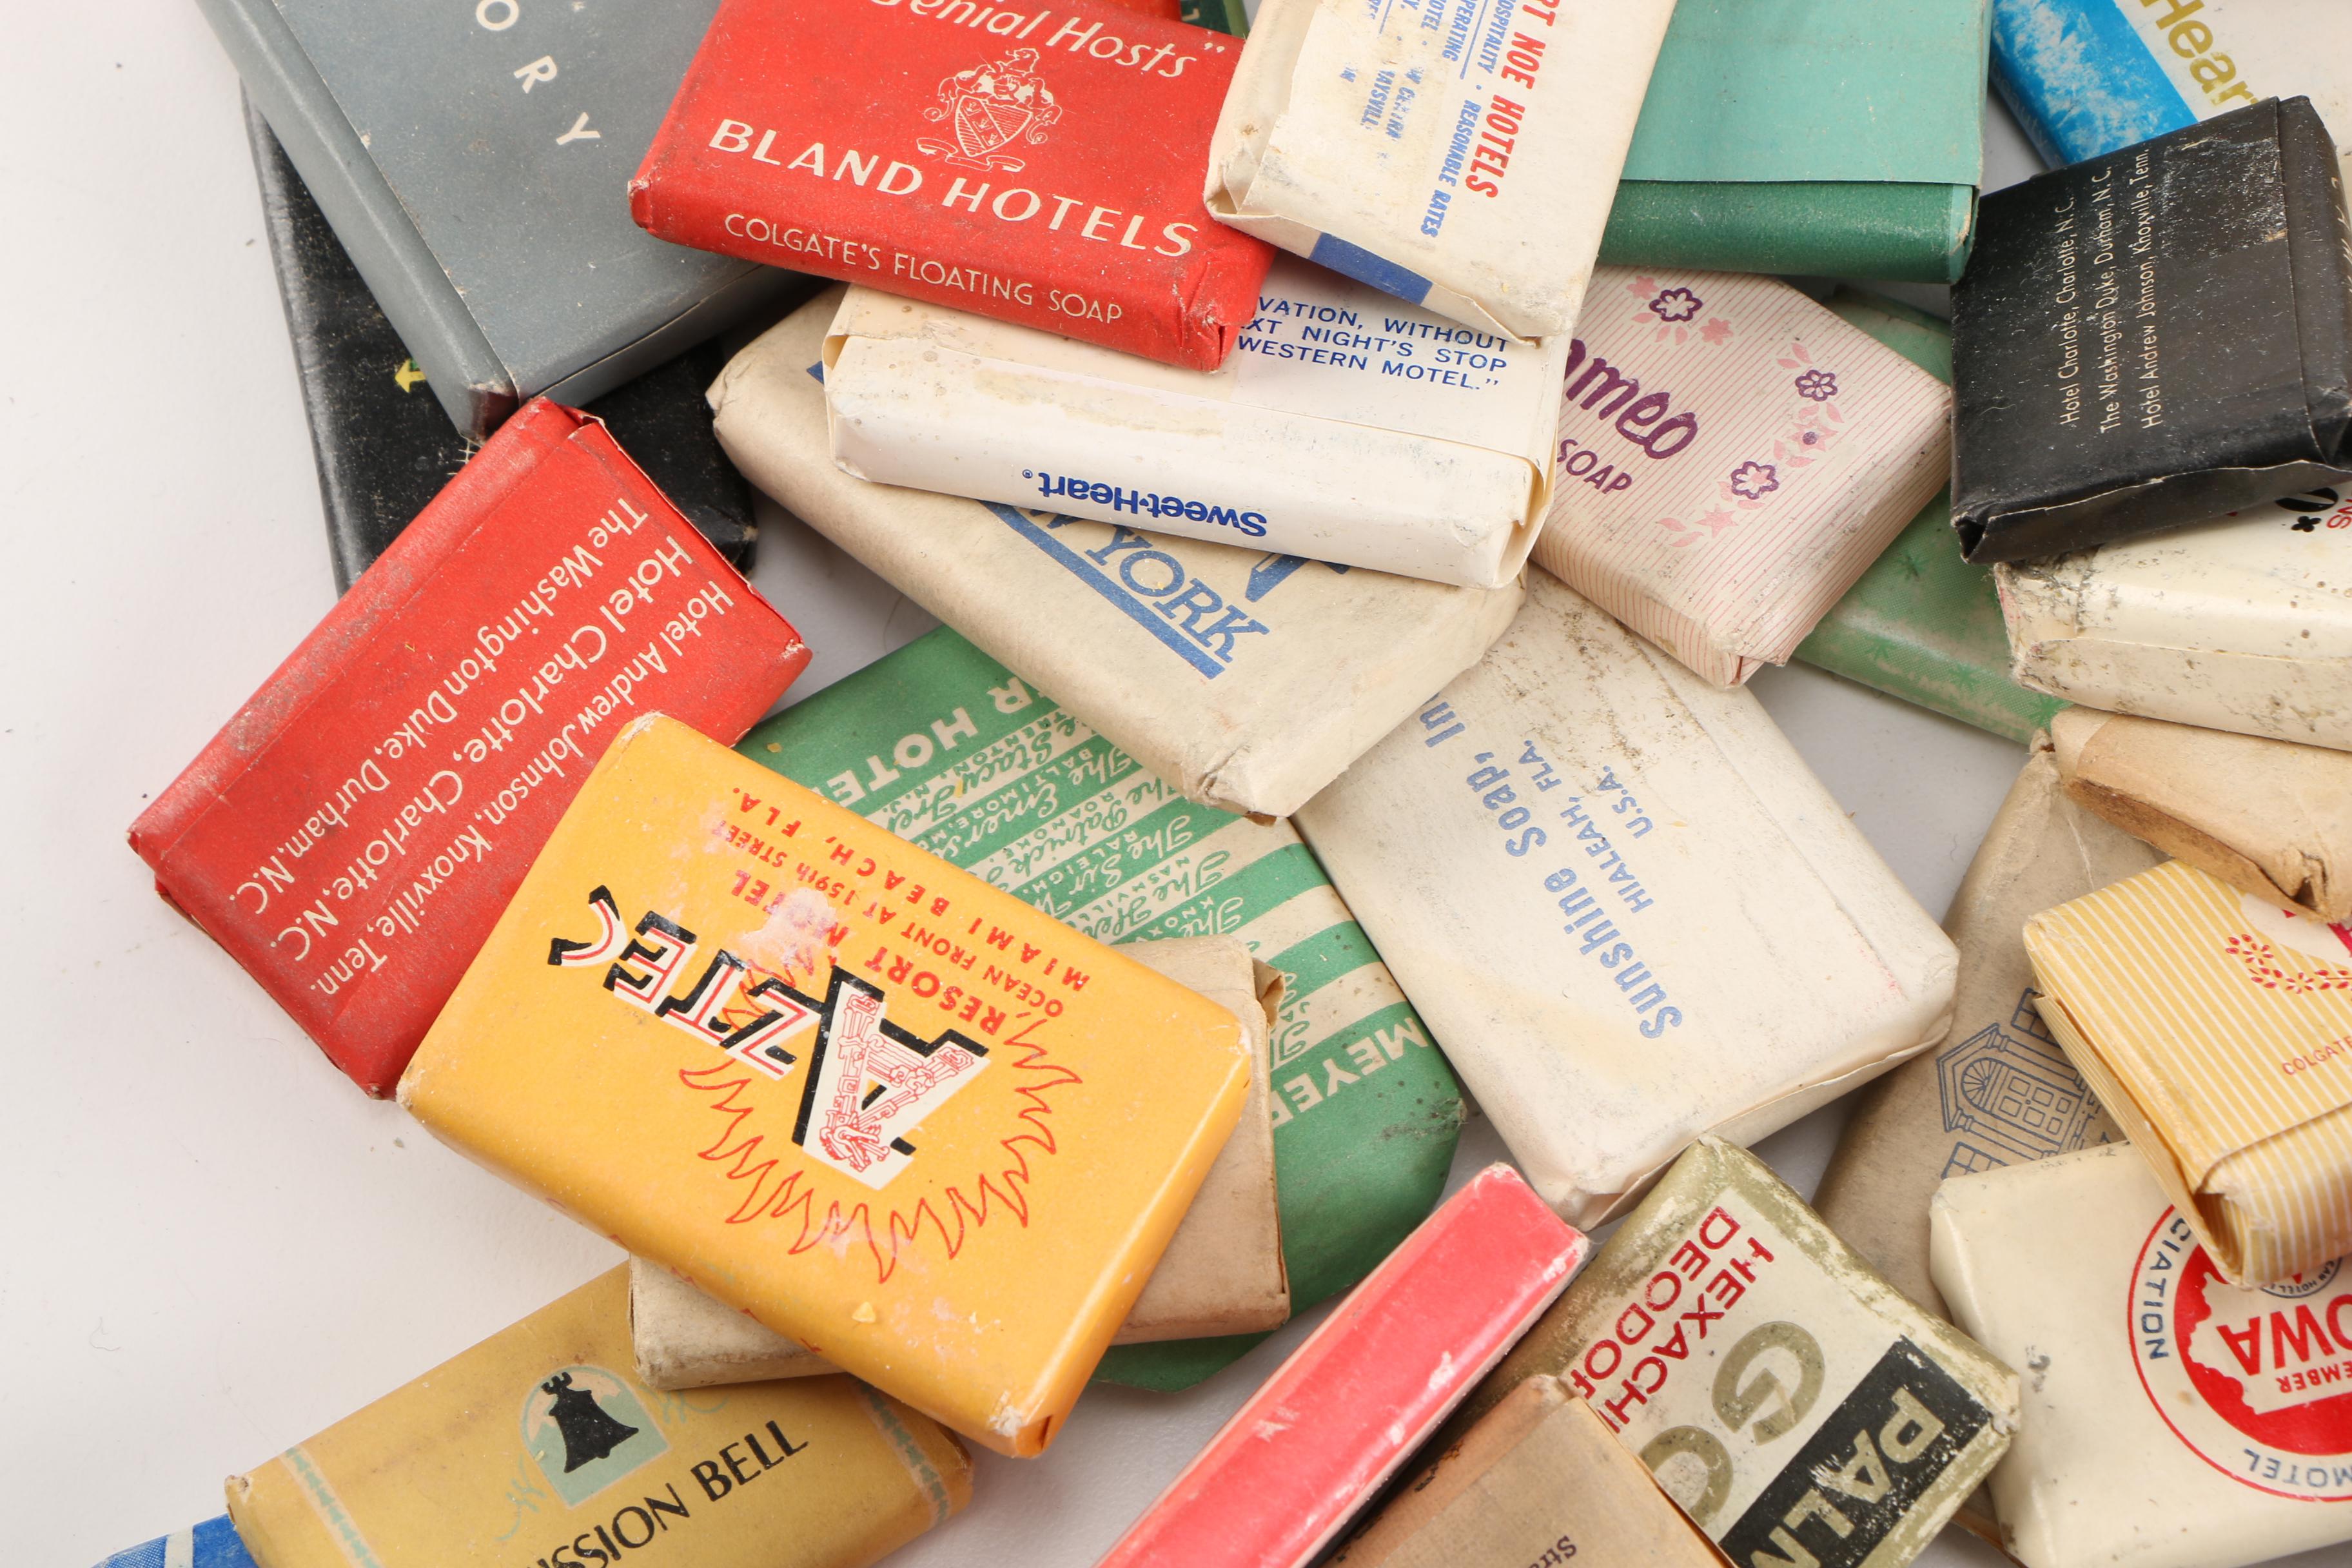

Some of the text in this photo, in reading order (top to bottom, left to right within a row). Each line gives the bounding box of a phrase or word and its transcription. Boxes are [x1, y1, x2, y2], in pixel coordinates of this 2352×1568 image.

[870, 0, 1049, 39] enial
[2141, 0, 2259, 106] Hear
[1501, 32, 1546, 90] NOE
[1438, 100, 1482, 187] REASONABLE
[1465, 94, 1525, 198] HOTELS
[709, 119, 1199, 258] BLAND HOTELS
[1420, 190, 1451, 238] RATES
[725, 213, 1122, 324] COLGATE'S FLOATING SOAP
[2056, 233, 2077, 304] Charlotte,
[2093, 203, 2115, 265] Durham,
[2095, 265, 2118, 316] Duke,
[2129, 148, 2162, 429] Hotel Andrew Johnson, Knoxville, Tenn.
[1238, 335, 1368, 371] WESTERN
[1240, 317, 1508, 372] XT NIGHT'S STOP
[1384, 318, 1510, 353] WITHOUT
[2058, 306, 2079, 379] Charlotte,
[2099, 310, 2122, 400] Washington
[2060, 382, 2080, 426] Hotel
[2100, 401, 2121, 434] The
[1556, 438, 1632, 495] SOAP
[587, 498, 649, 548] The
[444, 544, 603, 696] Washington
[599, 535, 693, 634] Hotel
[1084, 524, 1270, 664] YORK
[373, 690, 458, 760] Duke,
[453, 625, 607, 763] Charlotte,
[309, 580, 734, 995] Hotel Andrew Johnson, Knoxville, Tenn.
[814, 707, 979, 808] HOTE
[276, 758, 391, 858] Durham,
[322, 770, 464, 901] Charlotte,
[732, 787, 802, 838] FLA.
[1015, 776, 1177, 877] he Patrick
[1130, 814, 1193, 860] The
[1518, 739, 1655, 914] HIALEAH, FLA.
[796, 861, 856, 905] 159th
[825, 836, 950, 917] BEACH,
[1068, 852, 1123, 896] Sir
[1152, 849, 1231, 902] The
[1419, 691, 1683, 1039] Sunshine Soap, In
[863, 906, 896, 926] AT
[899, 921, 977, 970] FRONT
[864, 946, 1007, 1036] RESORT
[968, 917, 1090, 992] MIAMI
[982, 964, 1064, 1018] OCEAN
[527, 1420, 809, 1568] SSION BELL
